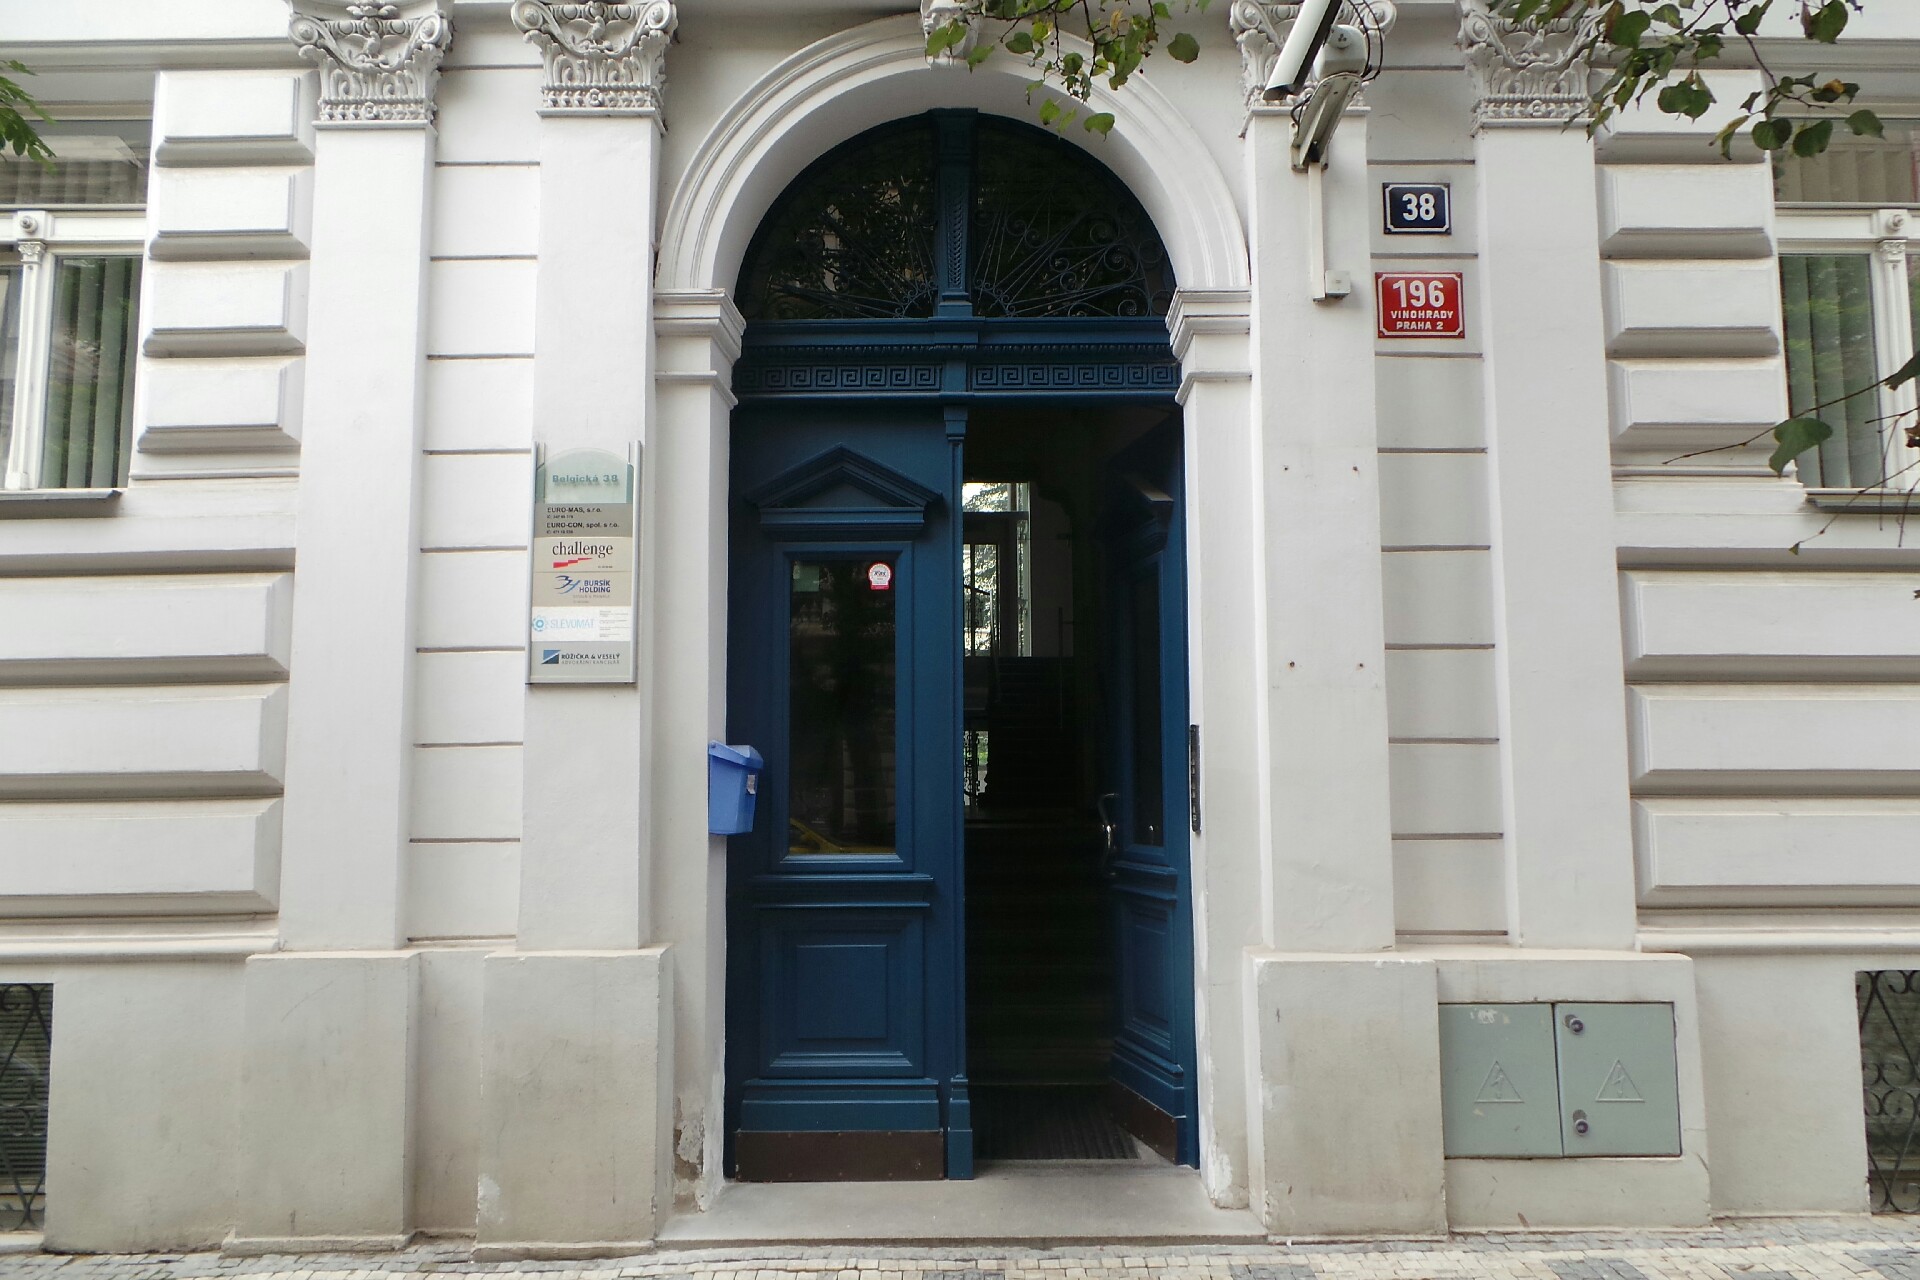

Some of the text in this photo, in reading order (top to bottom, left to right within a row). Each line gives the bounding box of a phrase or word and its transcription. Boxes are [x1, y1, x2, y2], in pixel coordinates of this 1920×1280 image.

[1402, 193, 1435, 221] 38
[1392, 280, 1445, 308] 196
[1390, 310, 1454, 319] VINOHRADY
[1396, 321, 1443, 330] PRAHA 2
[552, 474, 619, 485] Belgická 38
[552, 541, 613, 558] challenge
